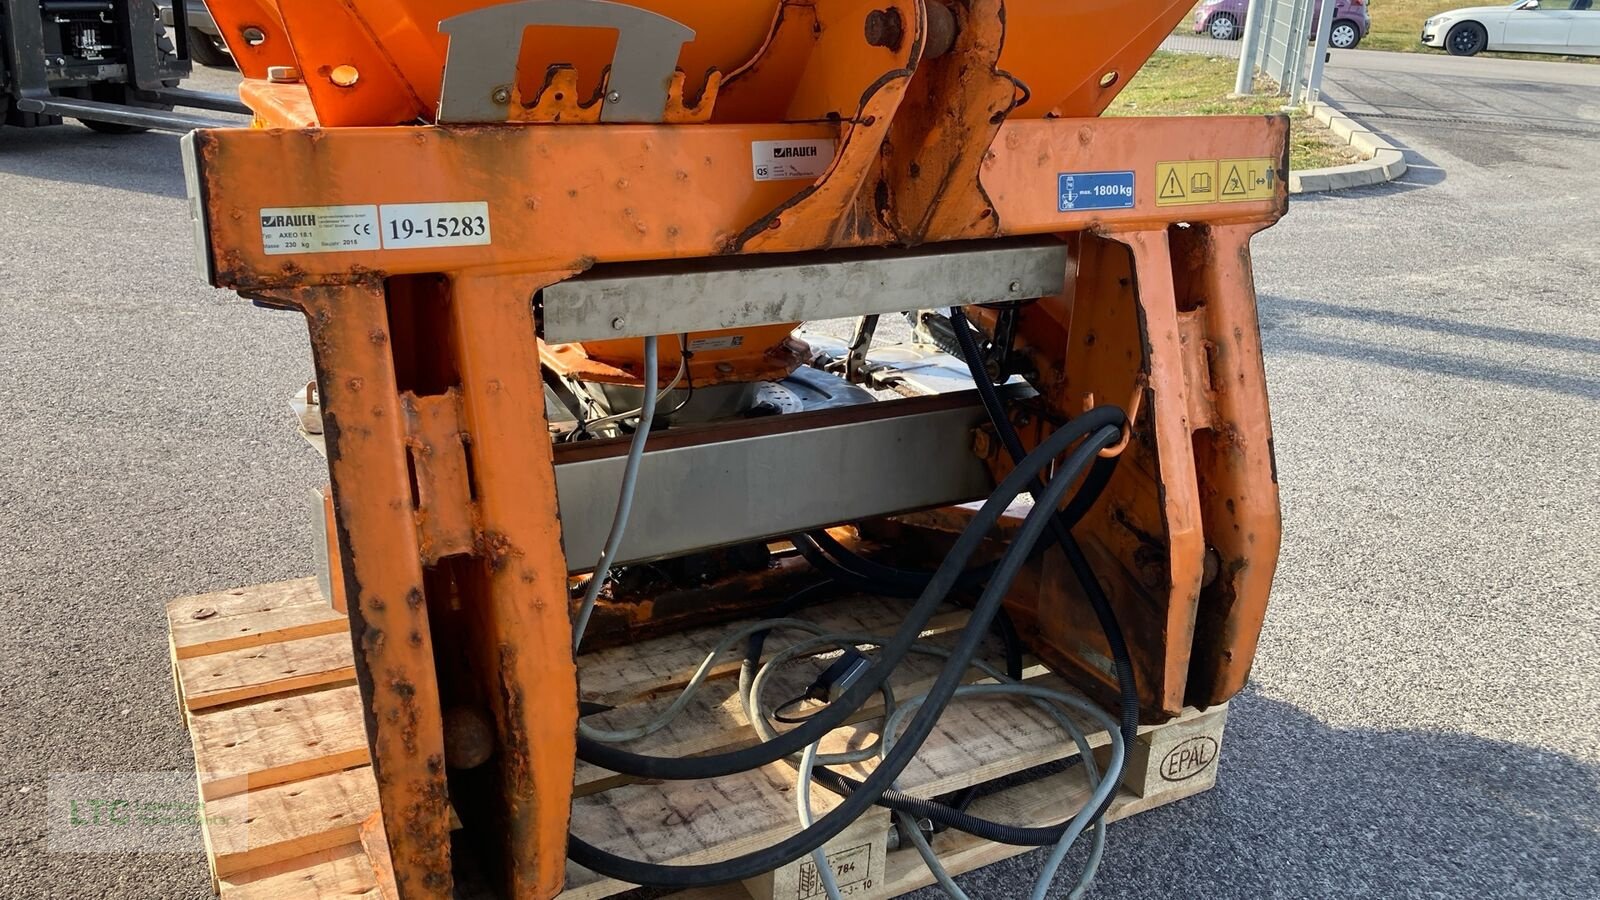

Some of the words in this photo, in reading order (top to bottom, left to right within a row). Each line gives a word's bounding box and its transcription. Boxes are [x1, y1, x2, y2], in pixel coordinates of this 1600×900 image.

[785, 146, 817, 158] RAUCH
[757, 167, 768, 176] QS
[1093, 185, 1119, 196] 1800
[1120, 184, 1132, 197] kg
[276, 214, 316, 227] RAUCH
[389, 216, 486, 240] 19-15283
[1169, 743, 1208, 776] EPAL
[837, 861, 856, 876] 784
[862, 879, 872, 891] 10
